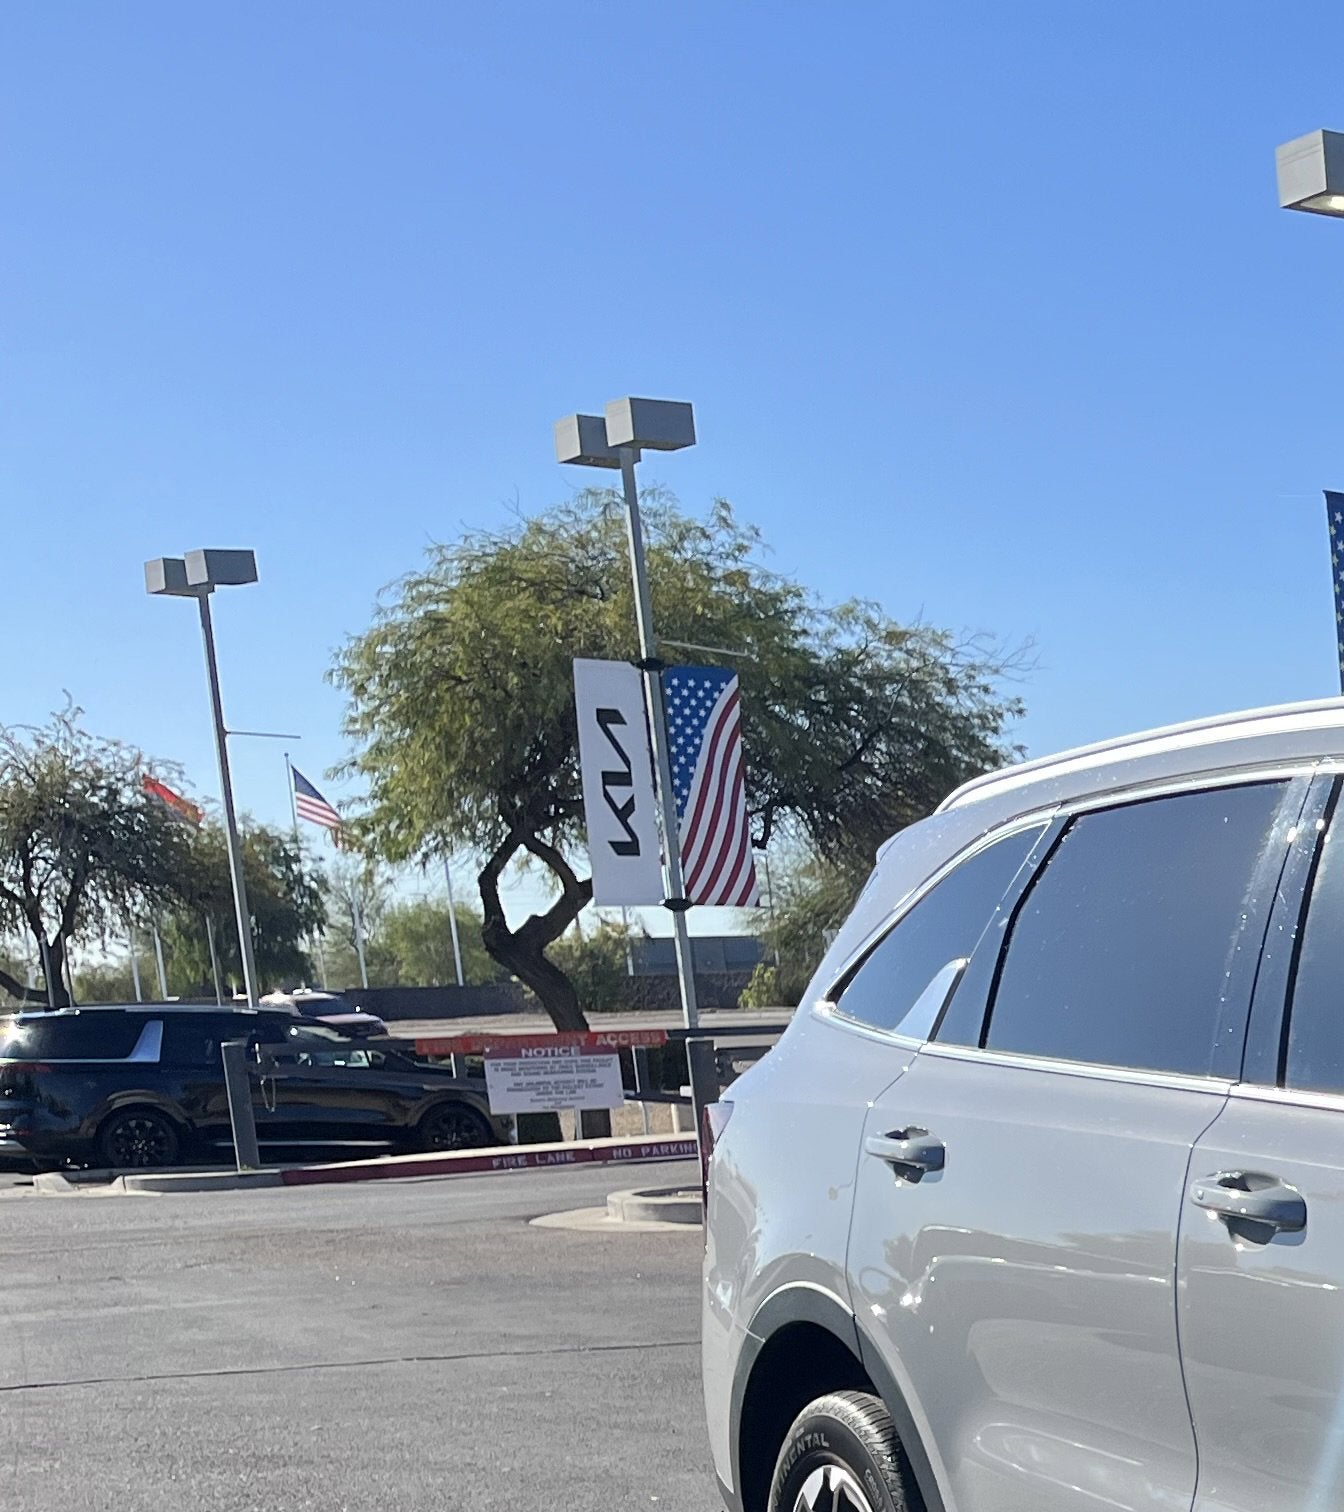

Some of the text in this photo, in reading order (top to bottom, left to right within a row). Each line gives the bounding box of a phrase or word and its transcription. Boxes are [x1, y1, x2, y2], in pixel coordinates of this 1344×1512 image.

[596, 708, 640, 856] KIA
[596, 1031, 661, 1046] ACCESS
[520, 1046, 580, 1058] NOTICE
[492, 1150, 576, 1169] FIRE LANE
[612, 1148, 632, 1159] NO
